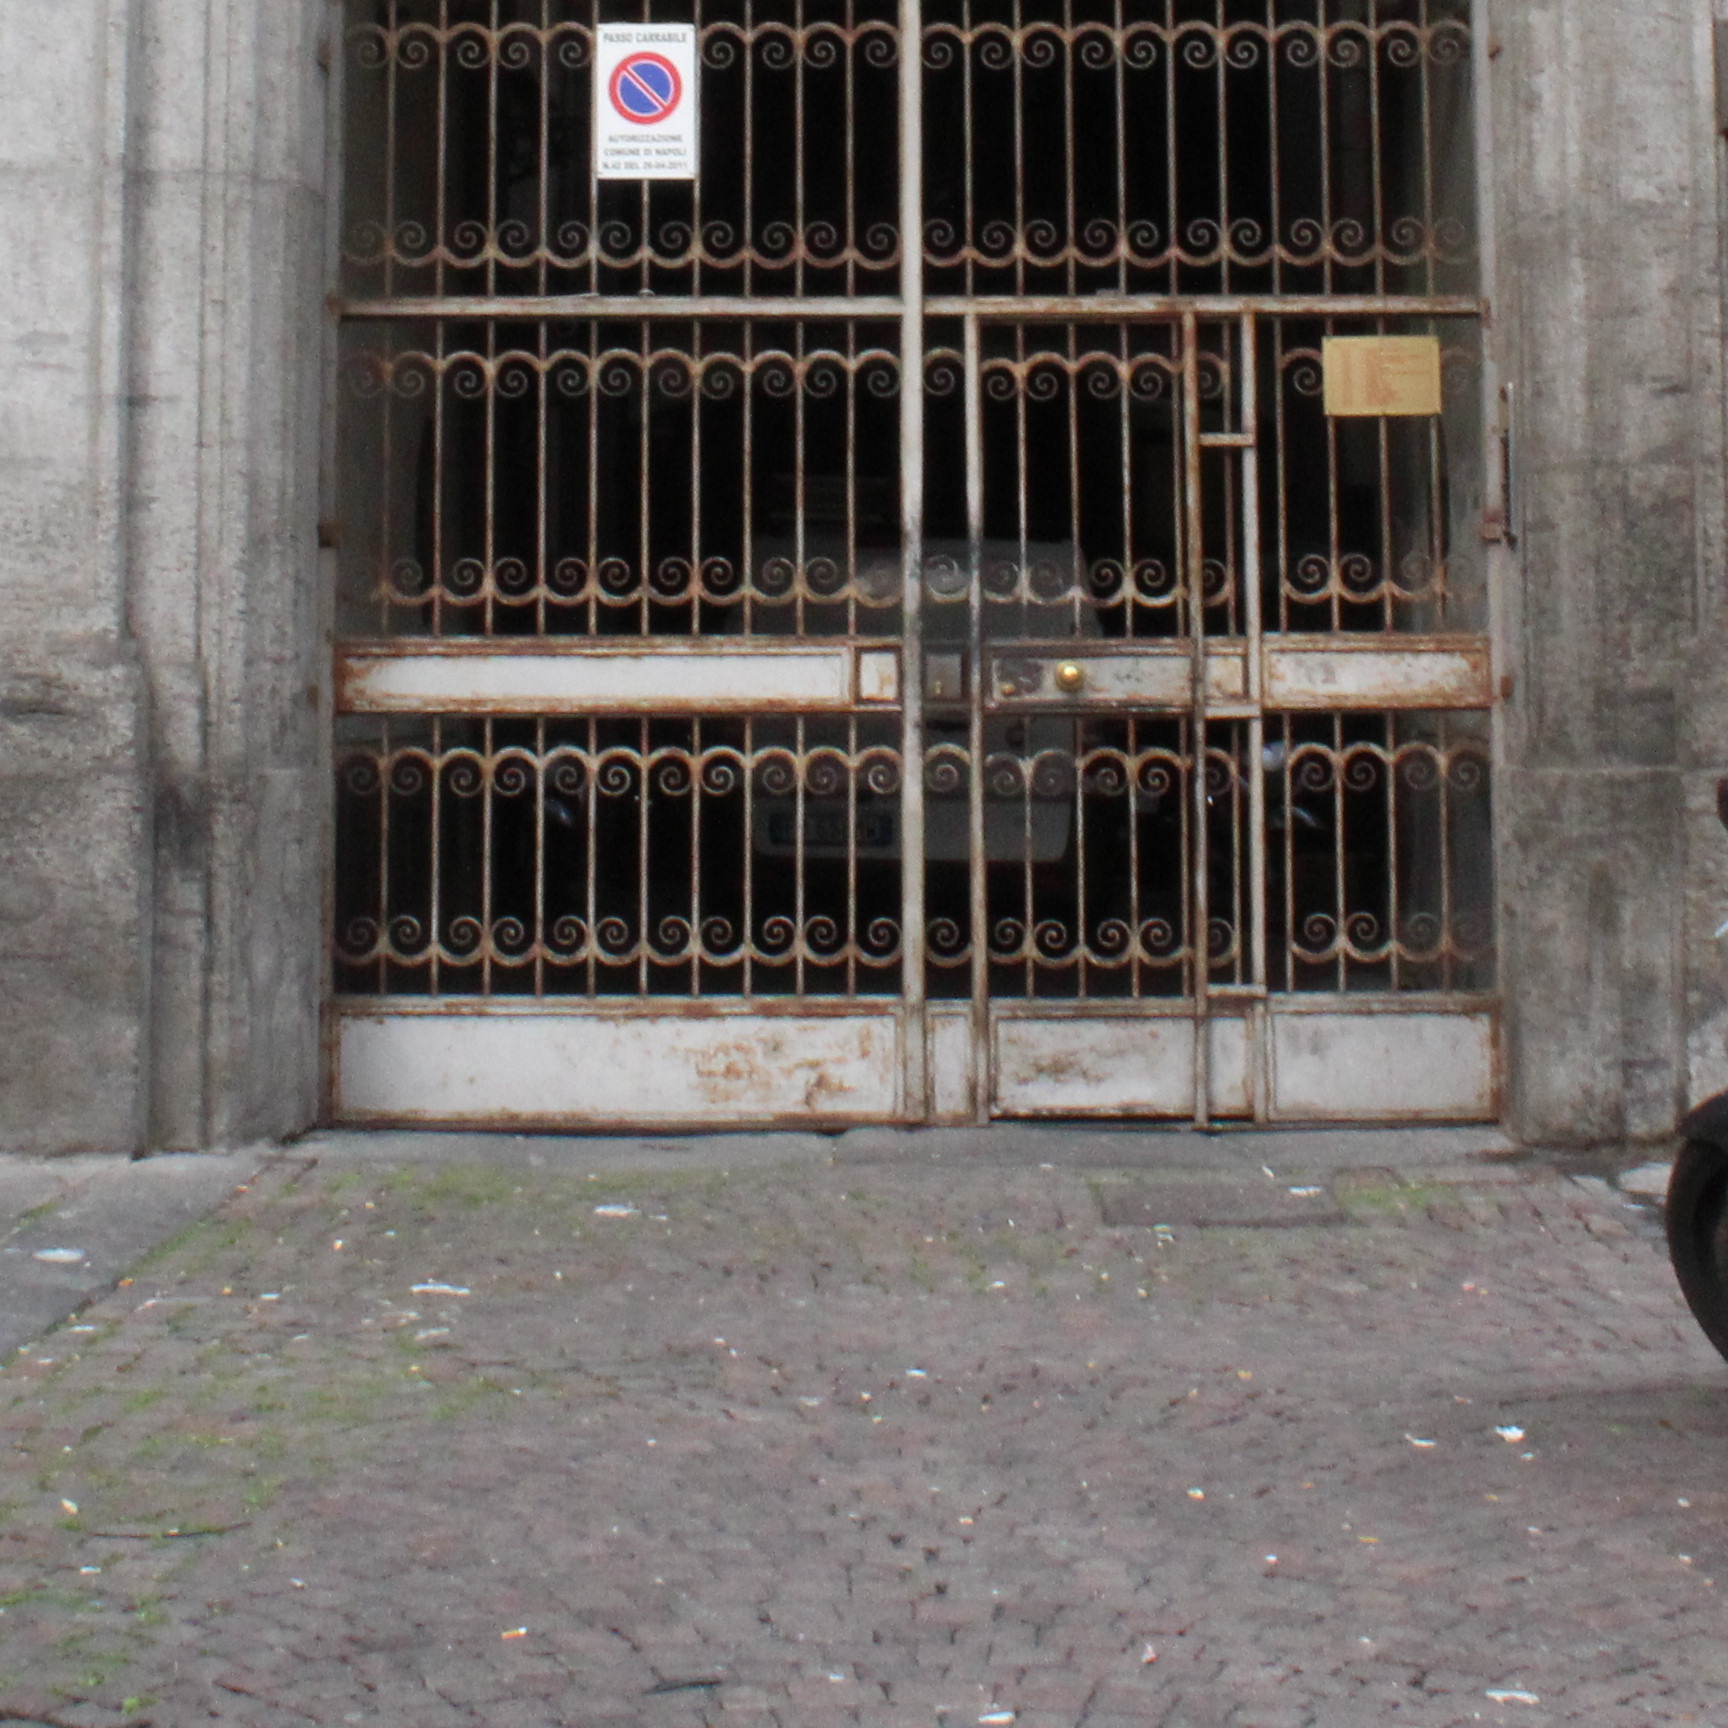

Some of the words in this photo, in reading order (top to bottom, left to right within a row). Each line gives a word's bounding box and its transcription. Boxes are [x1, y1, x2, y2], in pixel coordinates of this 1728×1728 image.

[603, 32, 633, 43] PASSO
[635, 32, 688, 43] CARRABILE
[655, 147, 687, 156] NAPOLI
